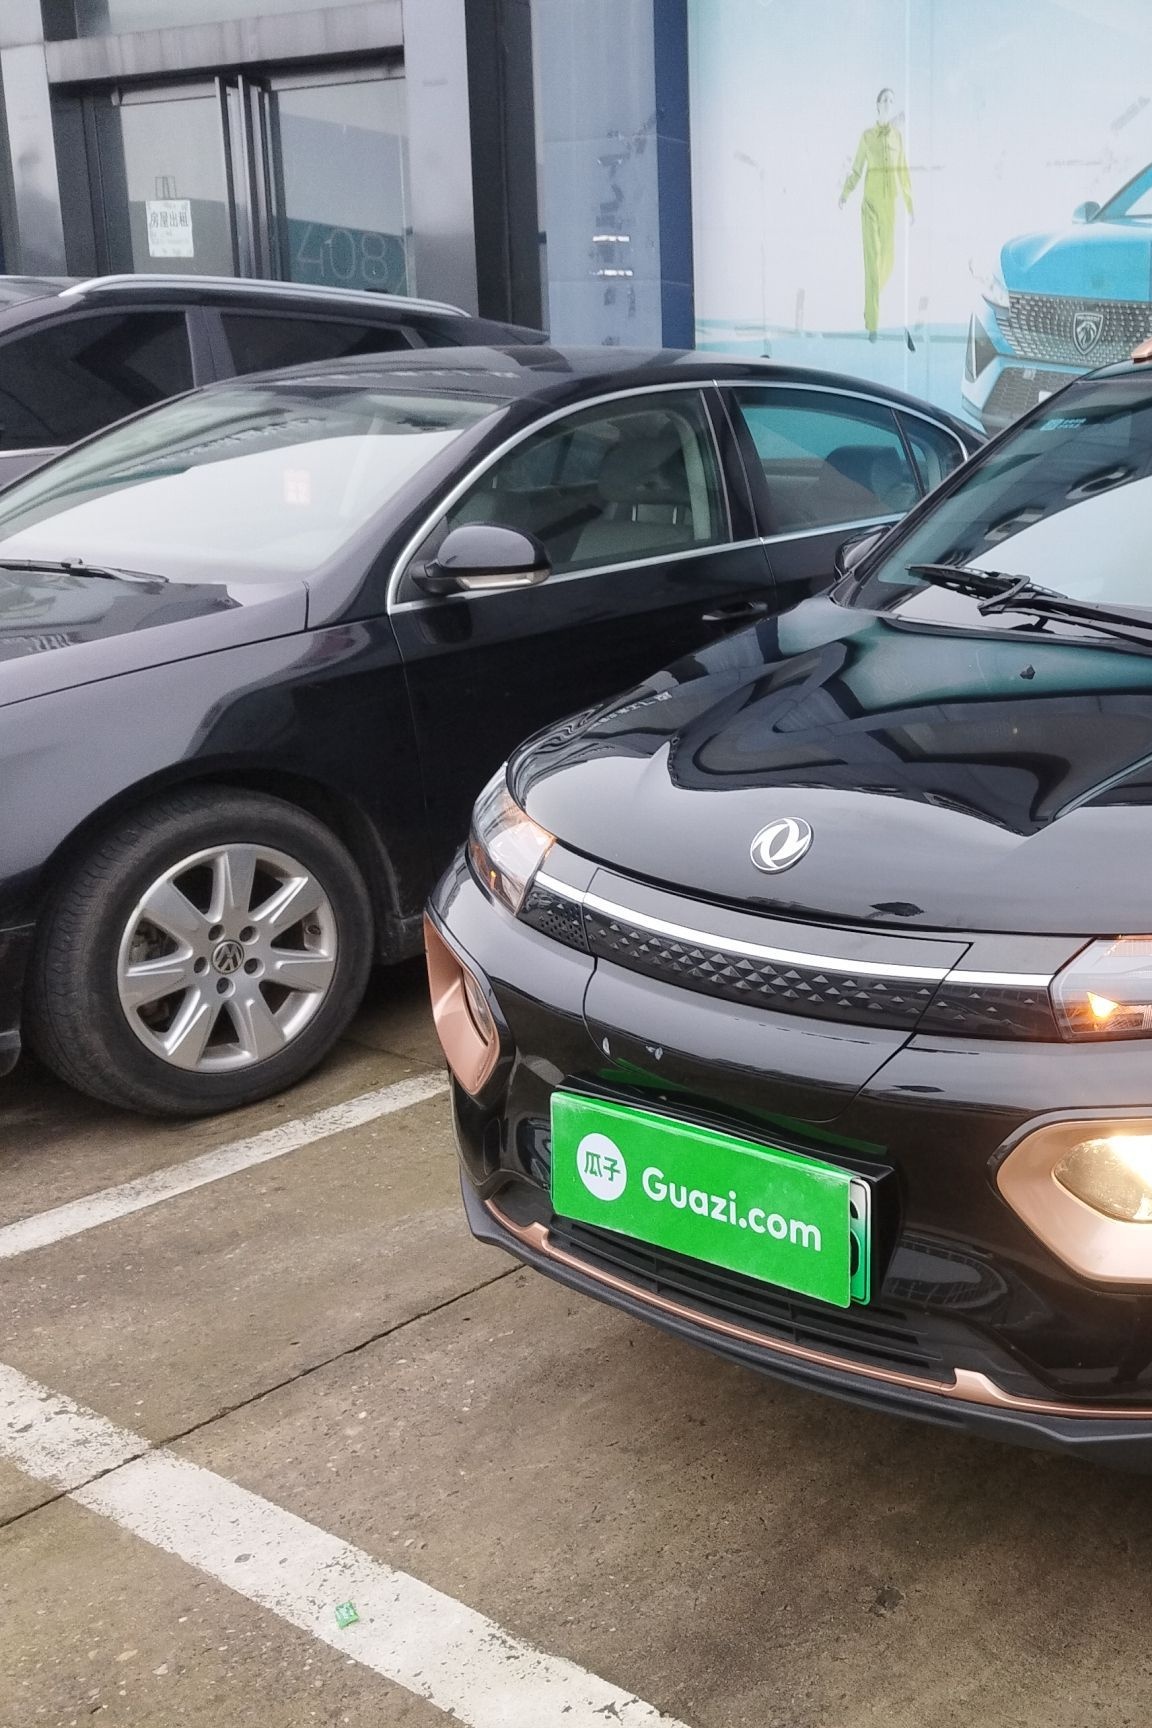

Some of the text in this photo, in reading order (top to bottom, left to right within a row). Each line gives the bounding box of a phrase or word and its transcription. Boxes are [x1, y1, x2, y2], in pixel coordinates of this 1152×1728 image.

[149, 210, 189, 229] 房屋出租
[583, 1150, 621, 1182] 瓜子
[642, 1167, 822, 1252] Guazi.com
